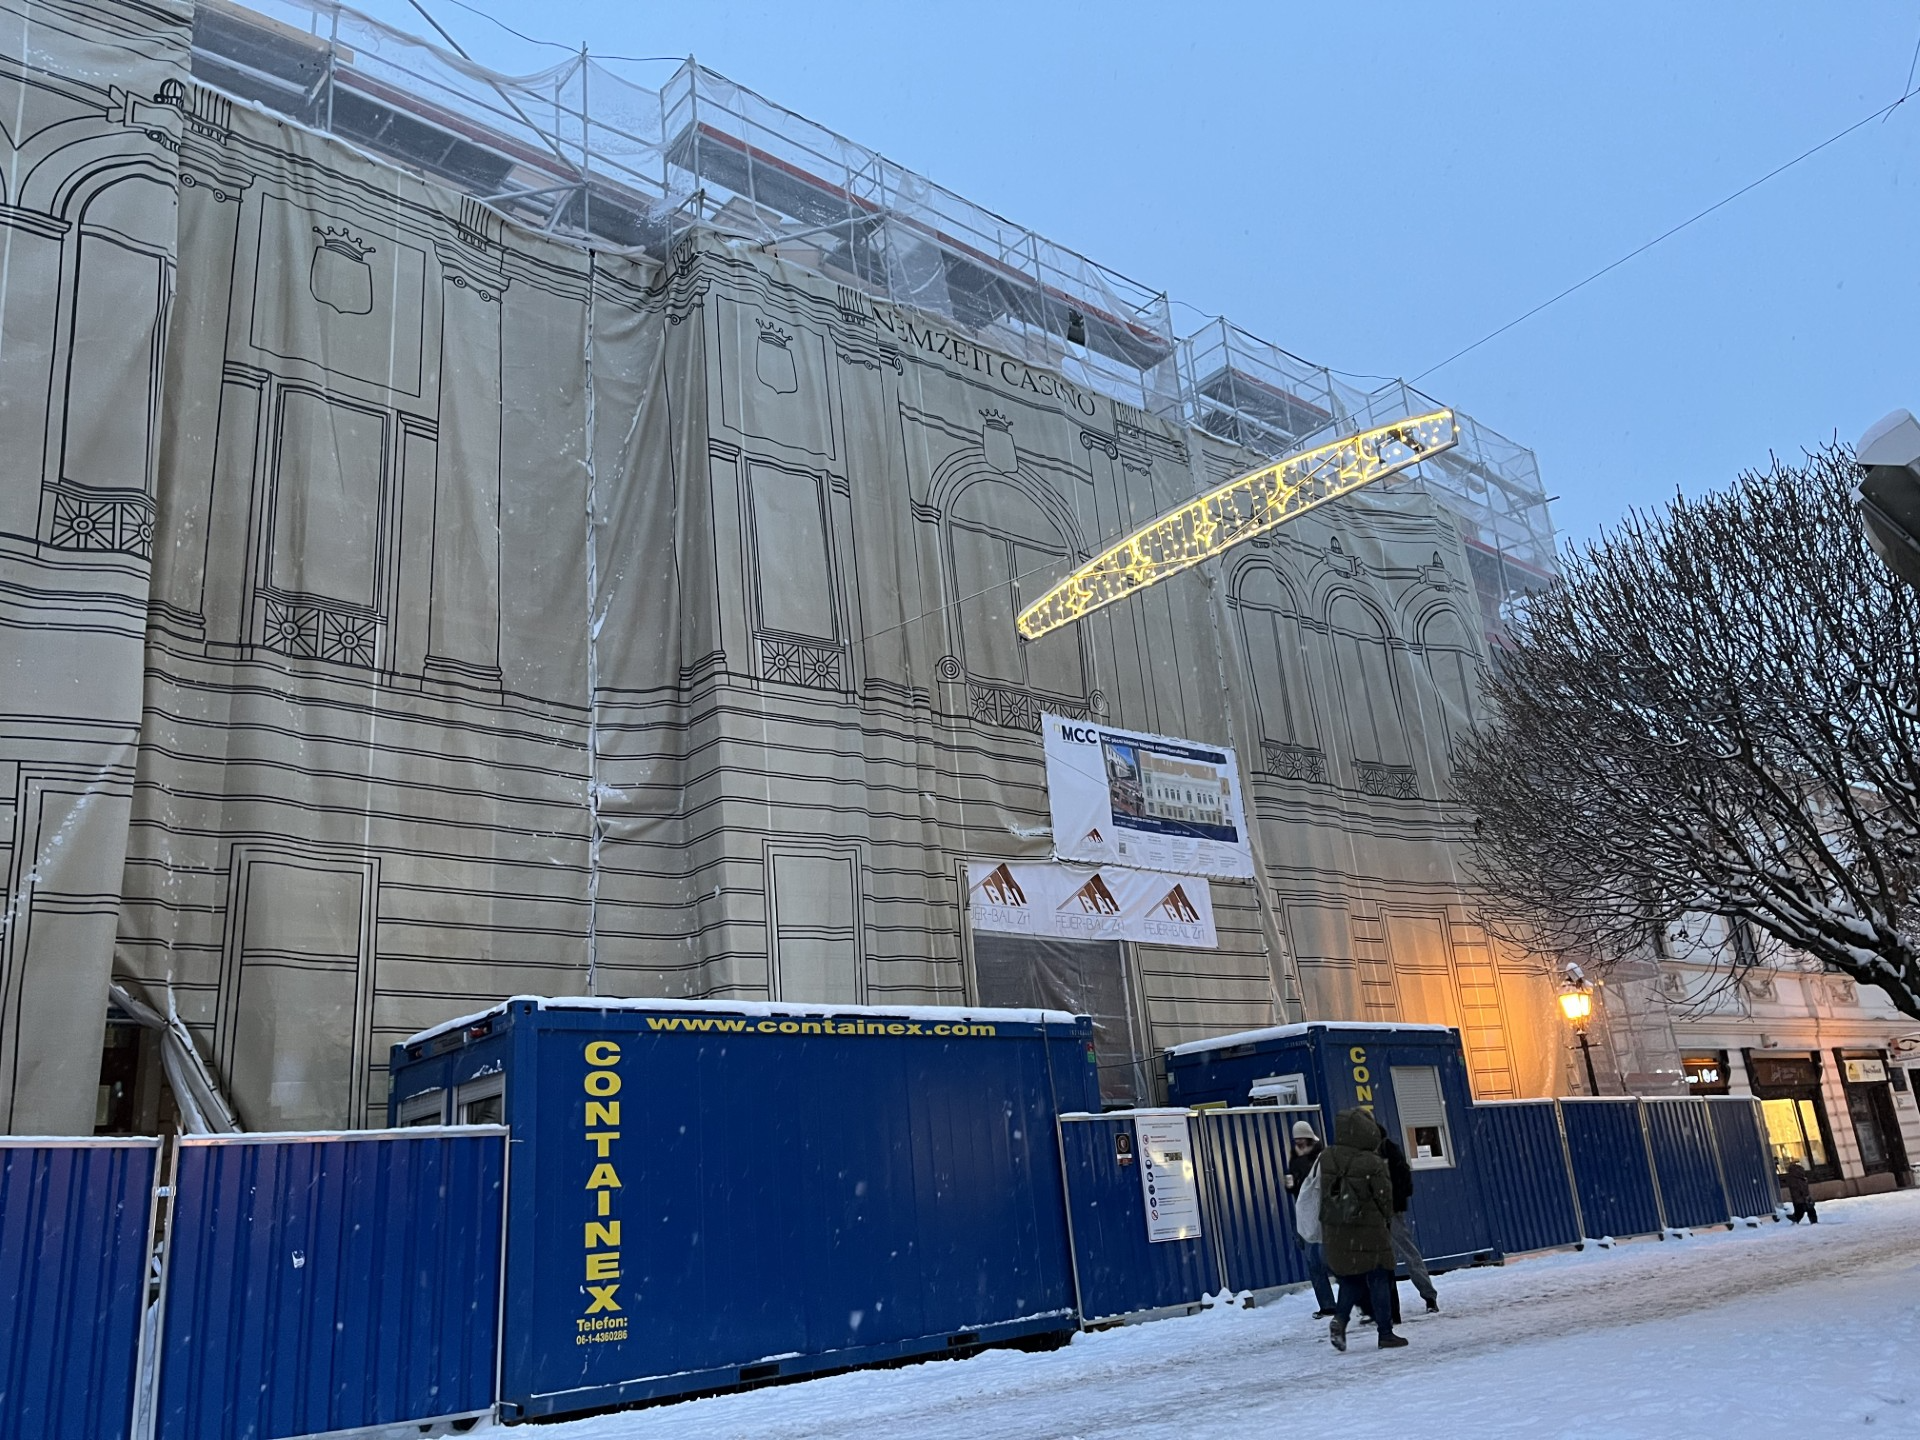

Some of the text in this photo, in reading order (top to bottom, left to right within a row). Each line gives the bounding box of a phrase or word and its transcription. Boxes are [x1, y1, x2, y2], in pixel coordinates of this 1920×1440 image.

[873, 306, 1095, 416] NEMZETI CASINO
[1062, 725, 1097, 744] MCC
[646, 1018, 996, 1037] www.containex.com
[1350, 1046, 1374, 1111] CON
[584, 1040, 622, 1314] CONTAINEX
[576, 1316, 628, 1332] Telefon:
